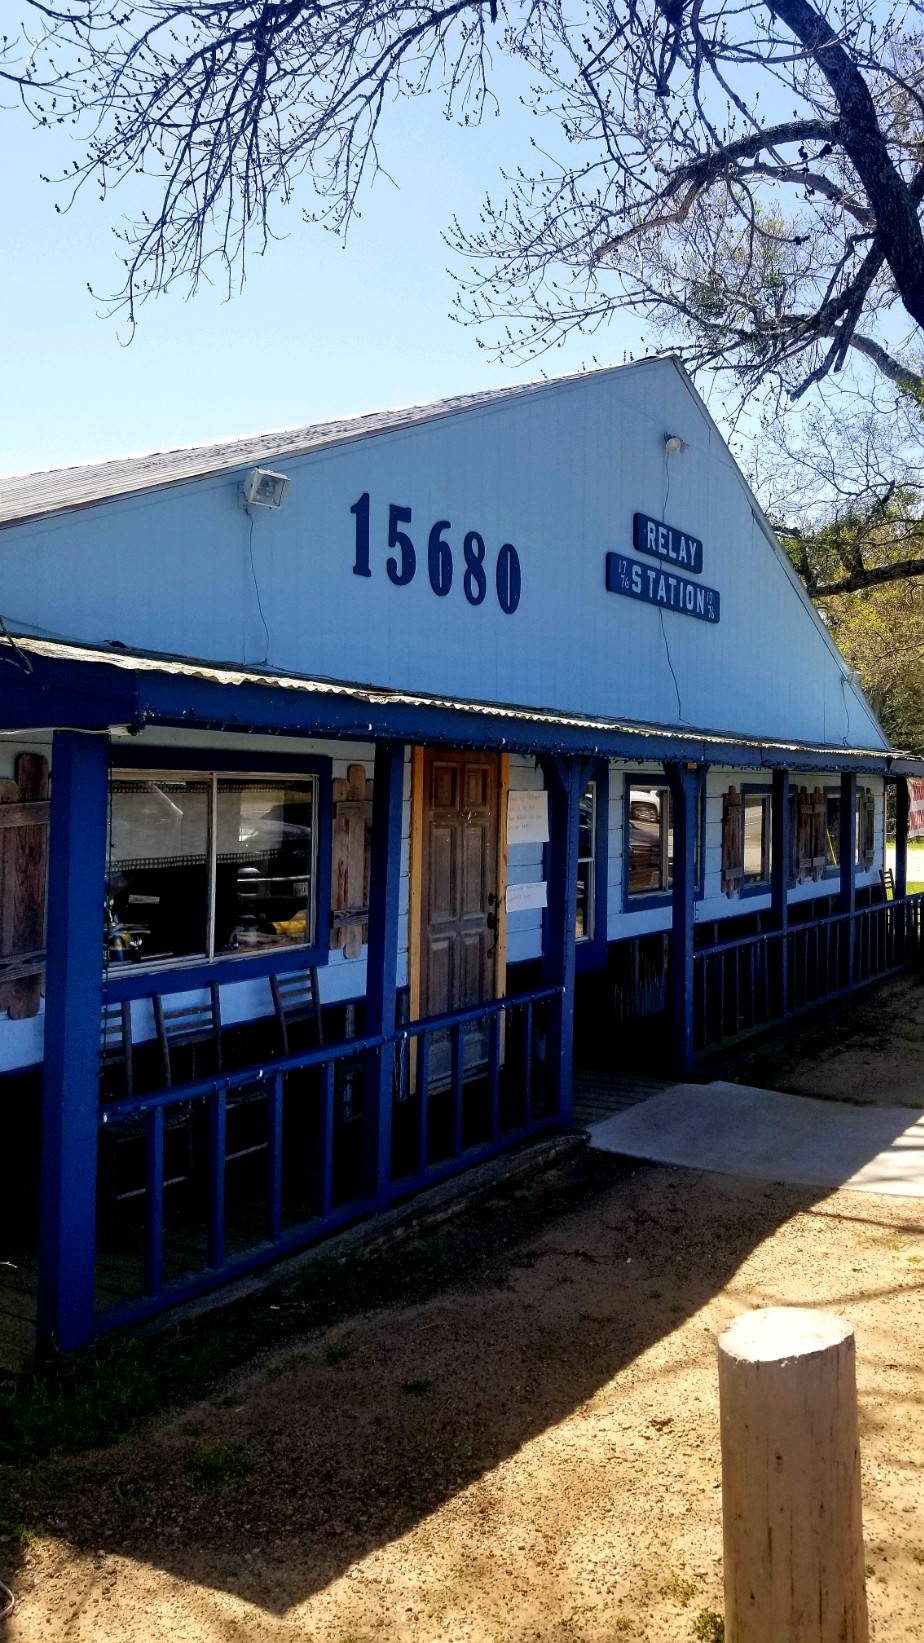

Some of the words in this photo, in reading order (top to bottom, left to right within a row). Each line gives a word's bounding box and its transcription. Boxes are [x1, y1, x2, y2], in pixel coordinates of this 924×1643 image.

[350, 492, 521, 614] 15680
[647, 521, 697, 566] RELAY
[631, 565, 705, 614] STATION
